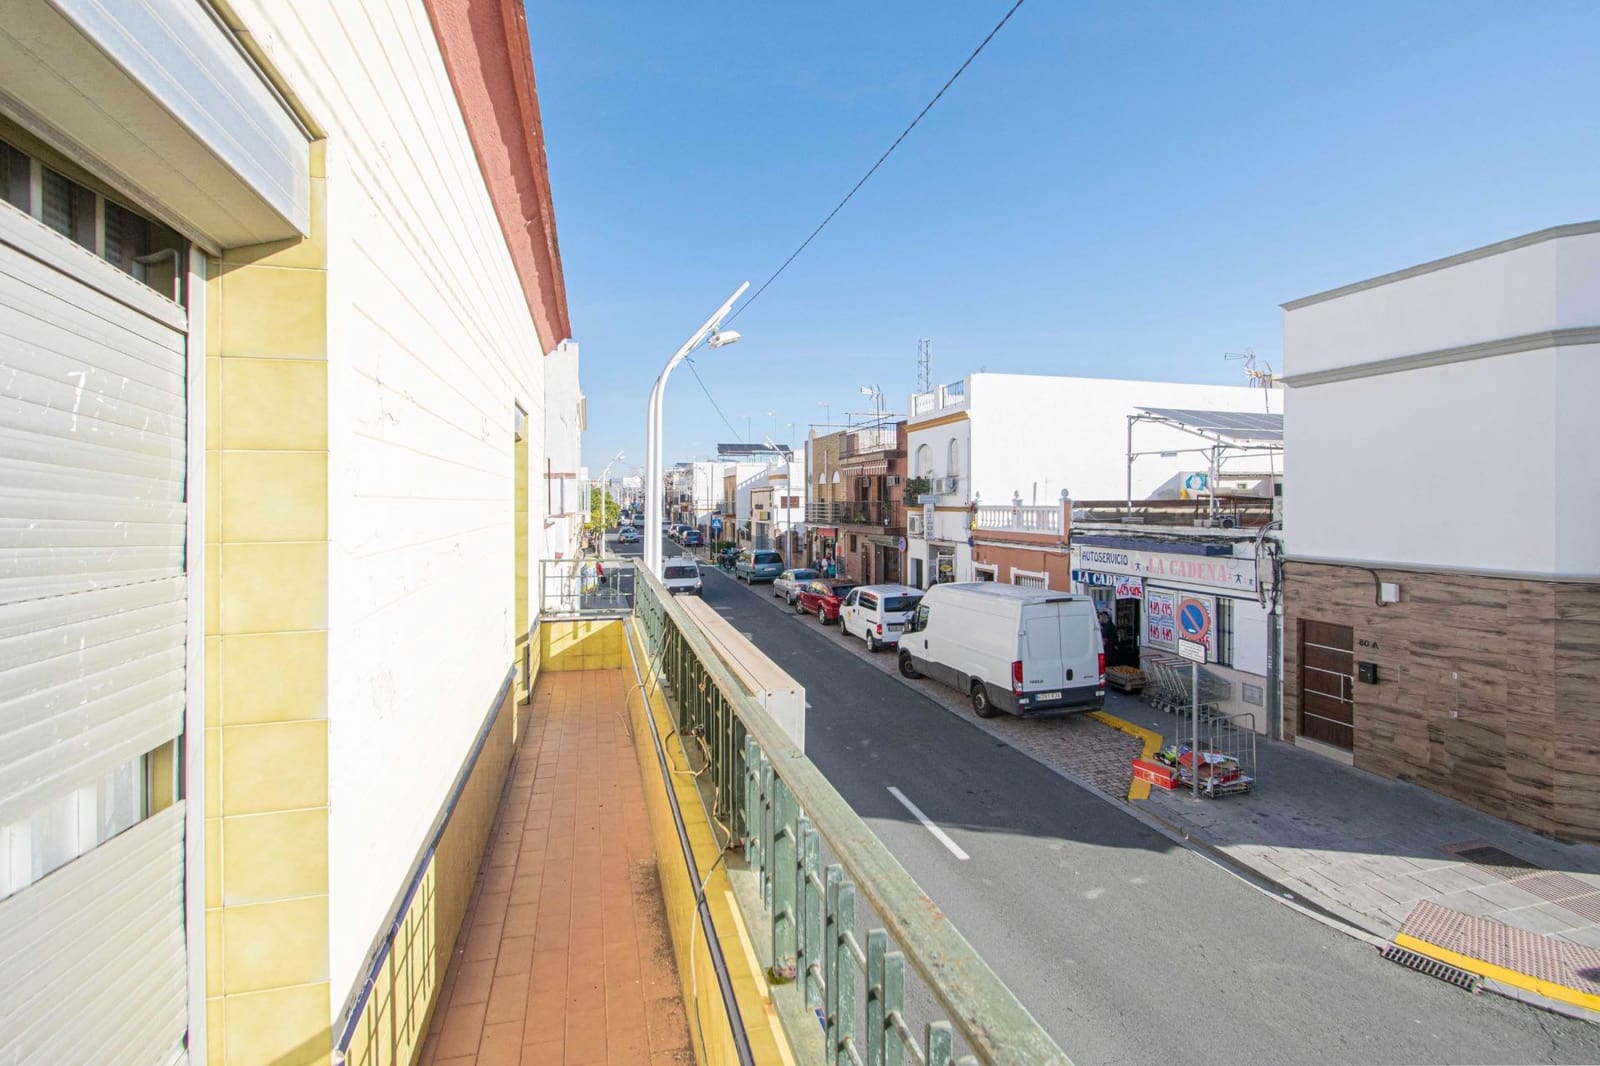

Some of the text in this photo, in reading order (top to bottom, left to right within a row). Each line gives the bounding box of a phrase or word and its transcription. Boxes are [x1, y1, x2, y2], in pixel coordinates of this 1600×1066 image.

[1082, 551, 1128, 565] AUTOSERVICIO
[1078, 571, 1089, 583] LA
[1149, 558, 1227, 582] LA CADENA
